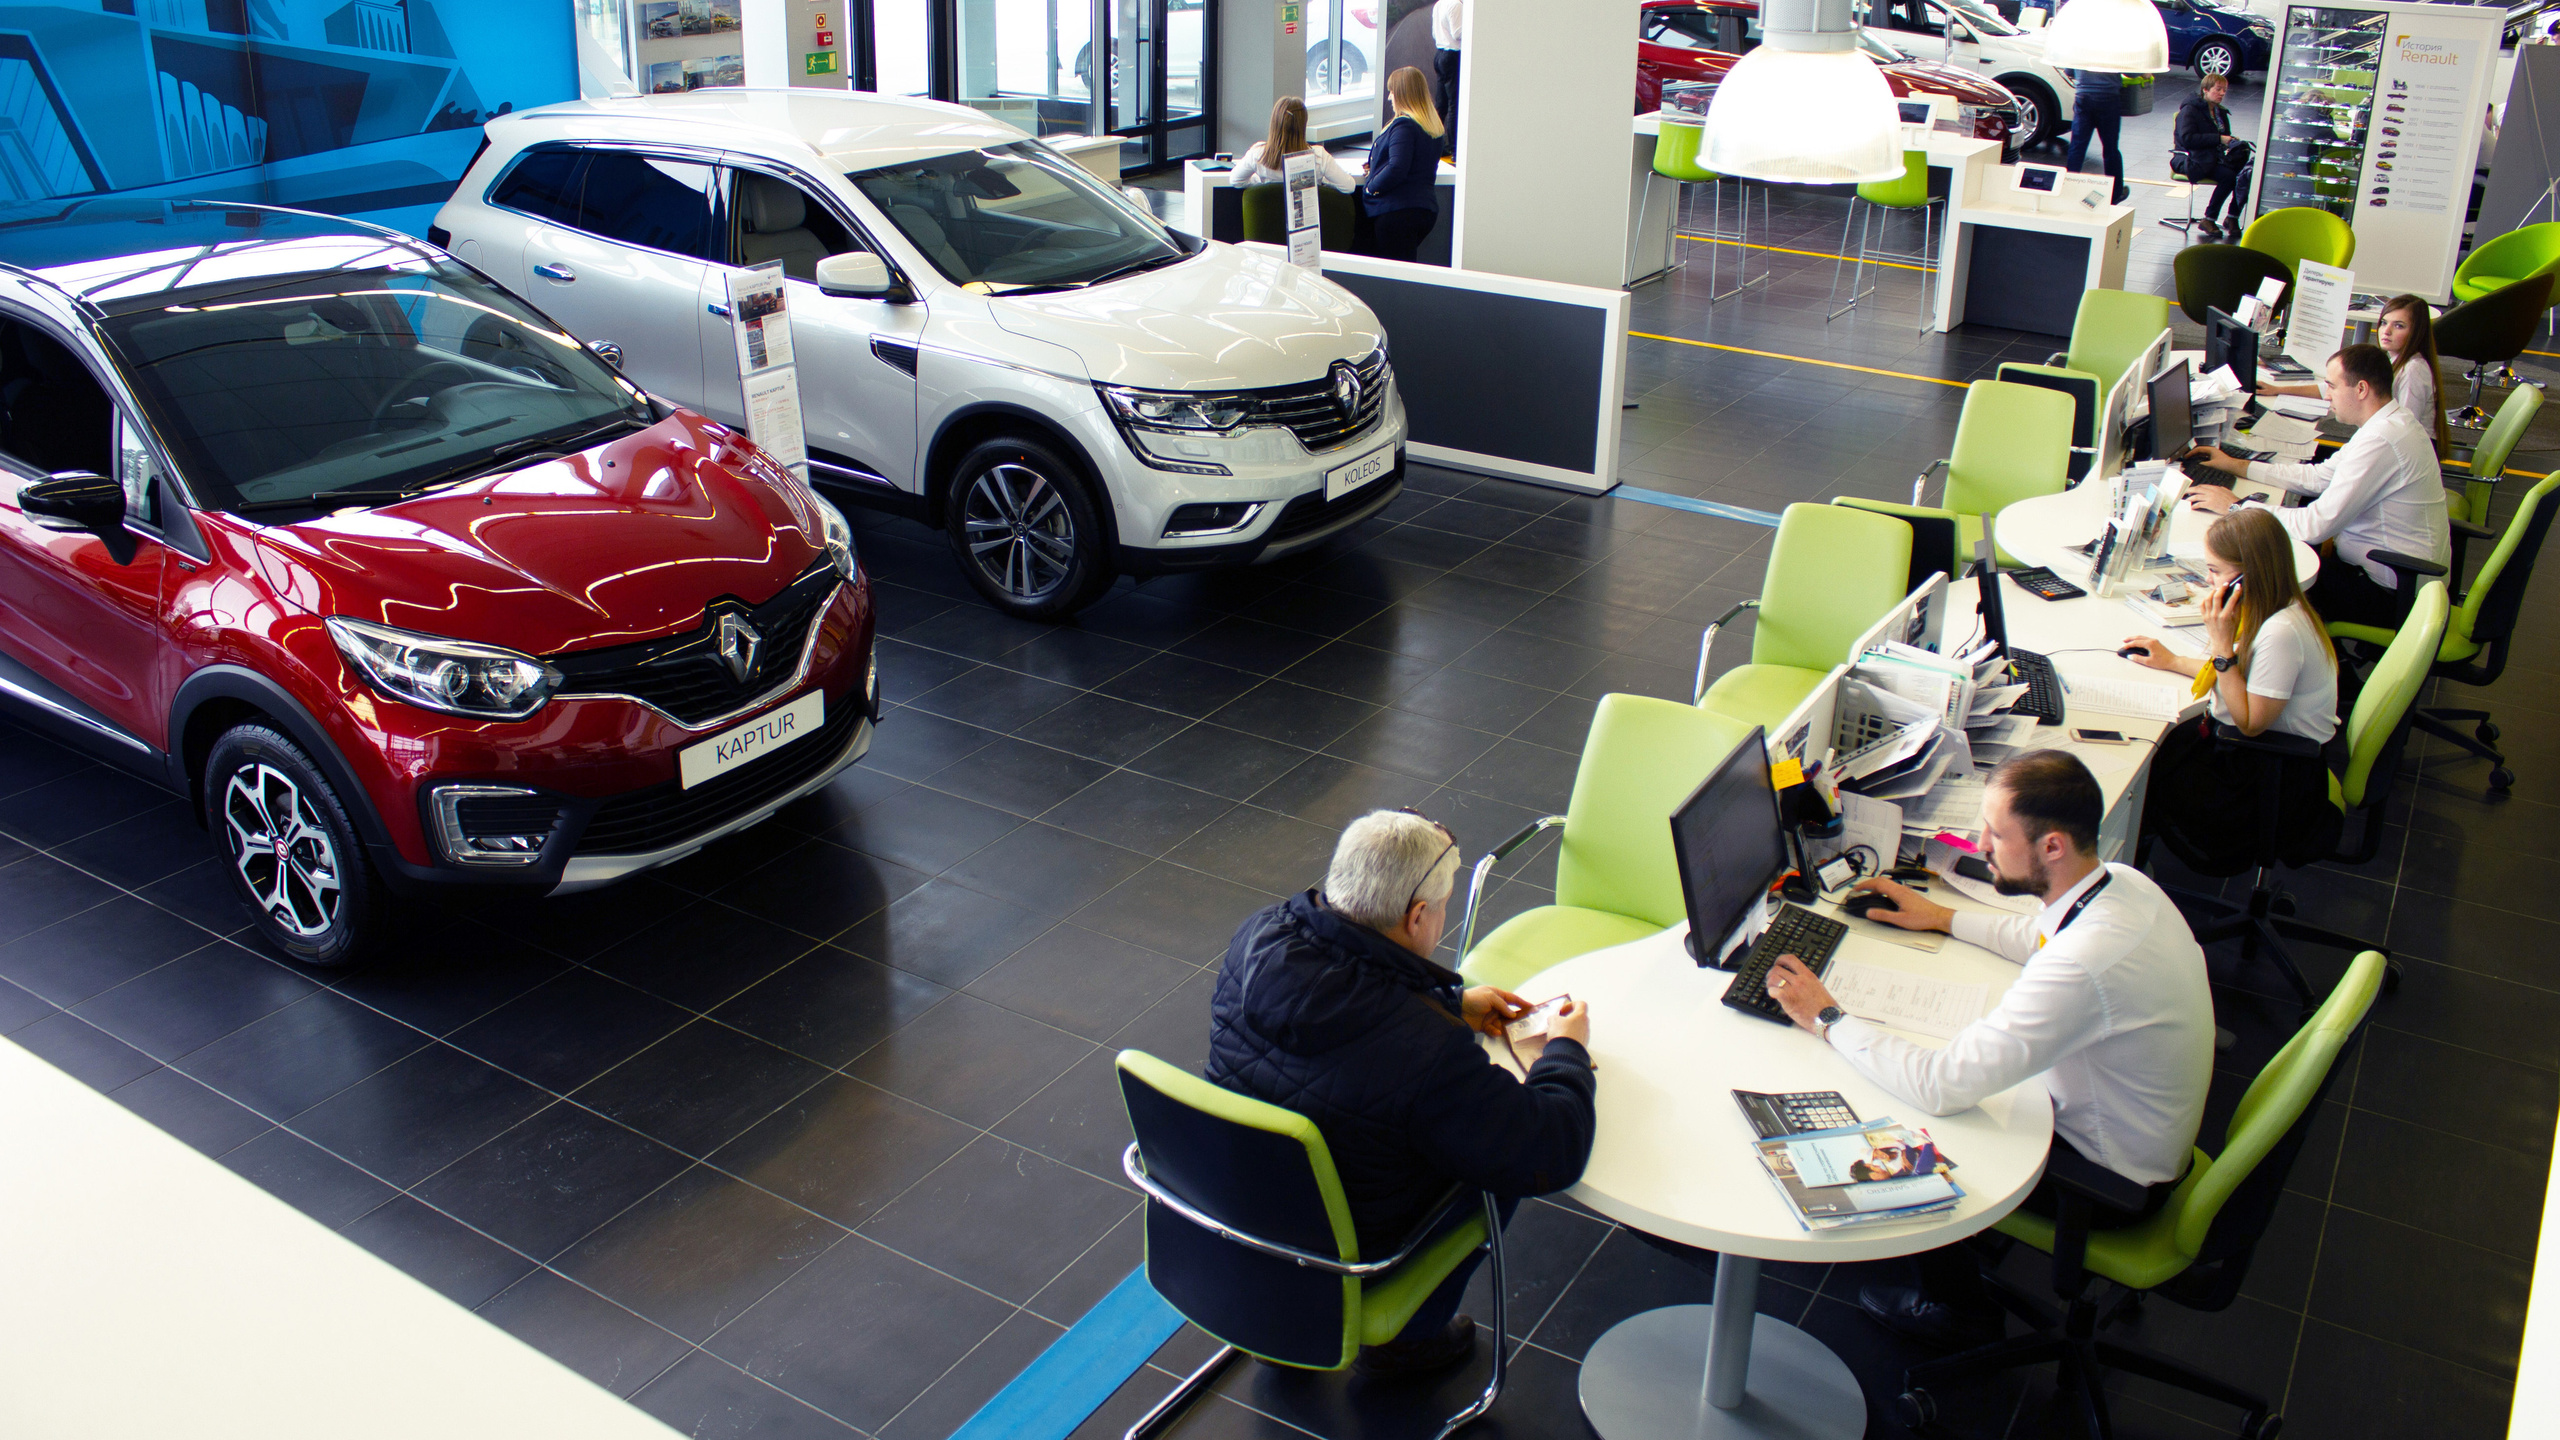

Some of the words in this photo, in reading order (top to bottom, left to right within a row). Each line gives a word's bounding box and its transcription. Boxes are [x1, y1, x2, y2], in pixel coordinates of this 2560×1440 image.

[2402, 41, 2443, 52] История
[2401, 49, 2459, 65] Renault
[2302, 275, 2335, 286] гарантируют
[1344, 456, 1381, 487] KOLEOS
[716, 712, 795, 764] KAPTUR
[1867, 1184, 1911, 1195] SANDERO
